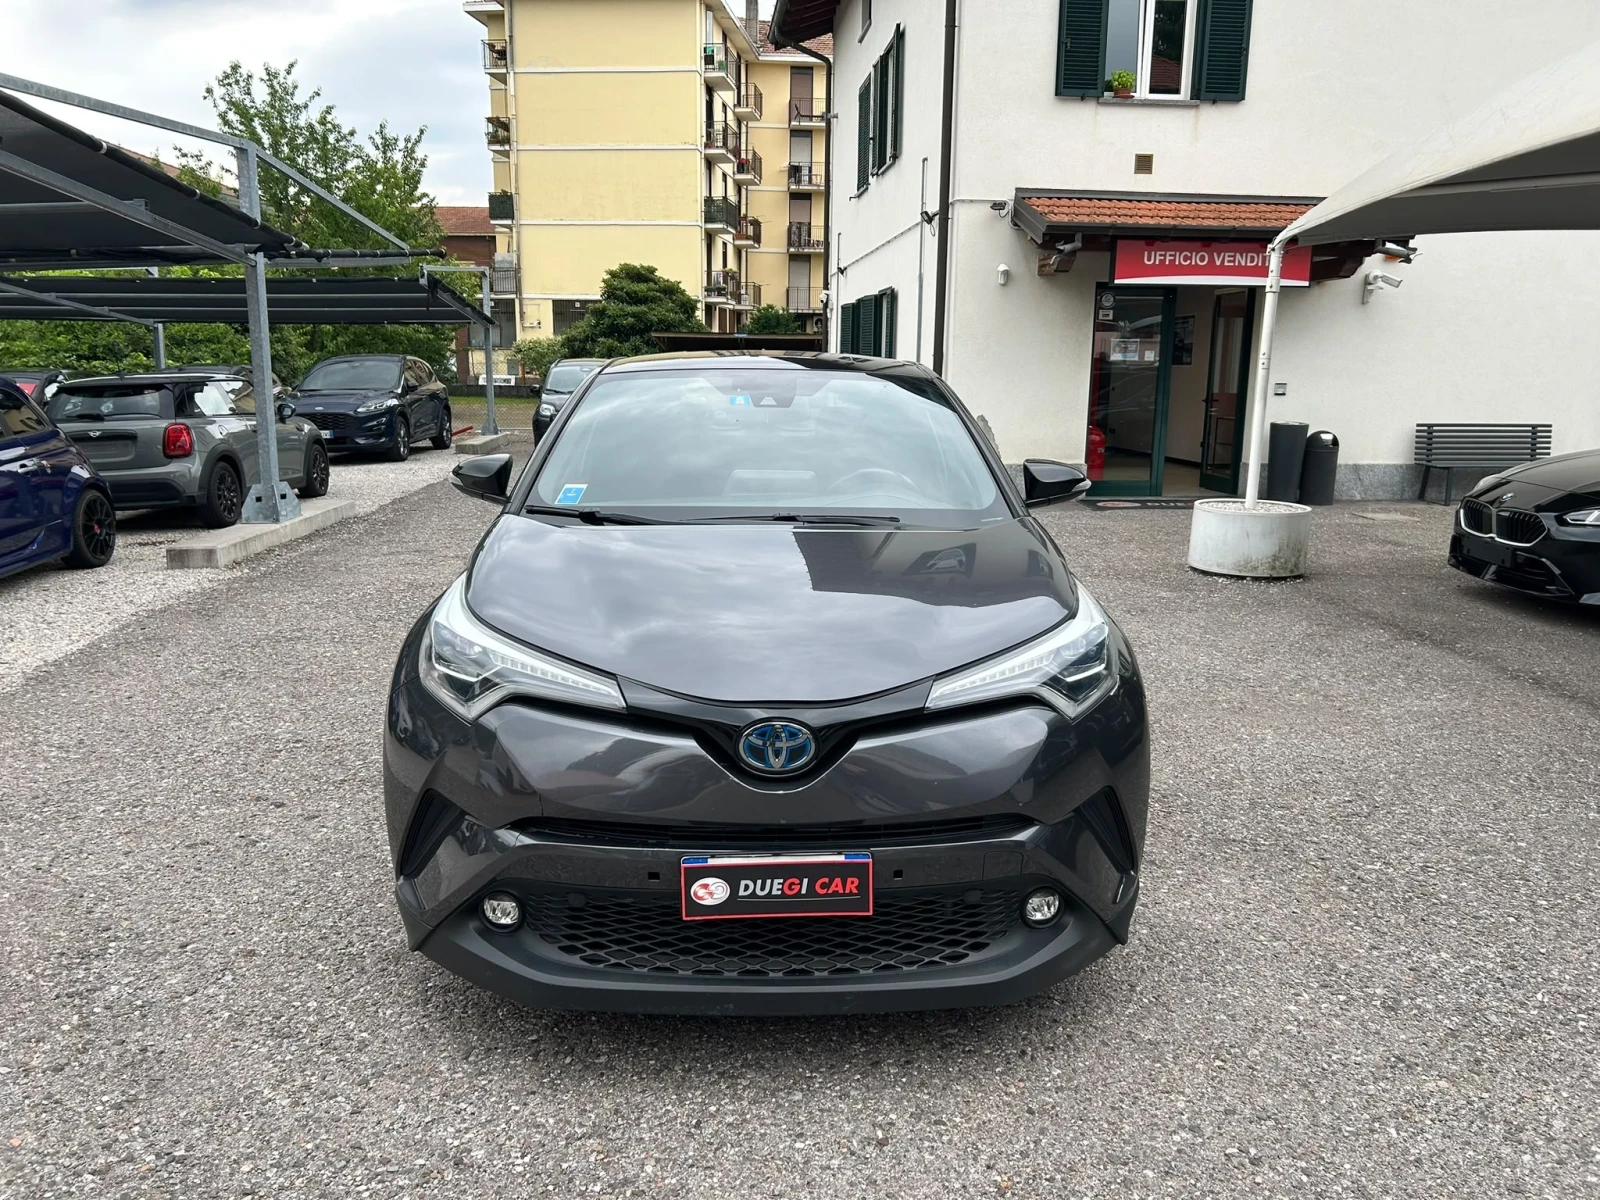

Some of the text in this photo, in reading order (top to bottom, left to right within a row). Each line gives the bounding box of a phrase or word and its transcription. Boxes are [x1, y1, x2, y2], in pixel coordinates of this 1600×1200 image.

[1143, 251, 1283, 267] UFFICIO VENDIT
[738, 877, 860, 897] DUEGI CAR
